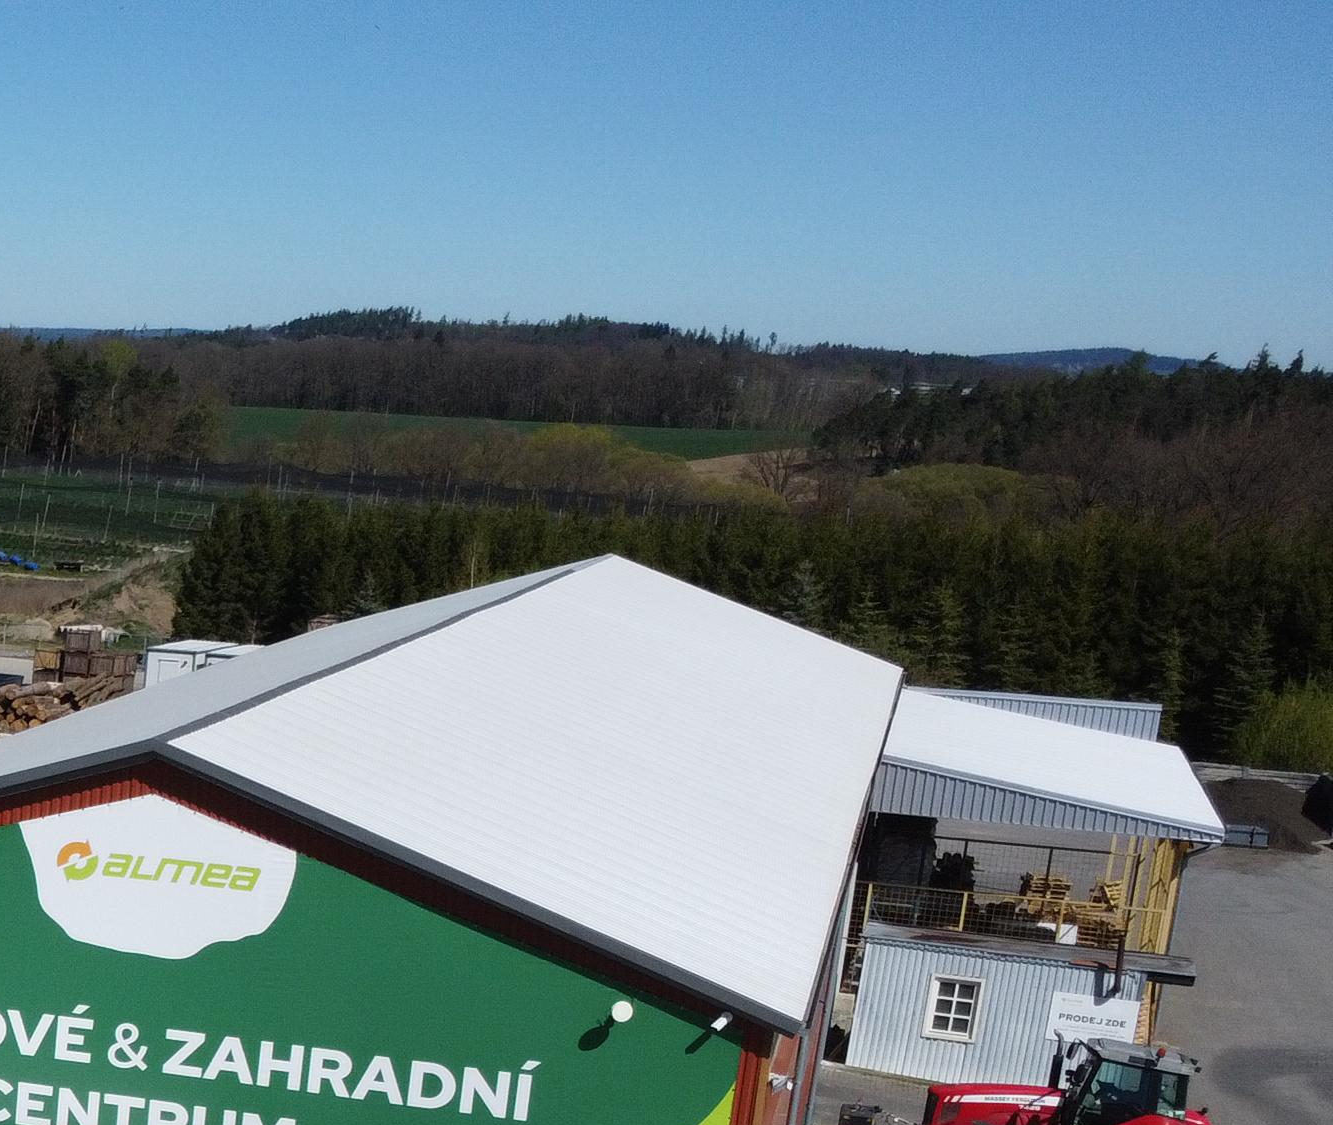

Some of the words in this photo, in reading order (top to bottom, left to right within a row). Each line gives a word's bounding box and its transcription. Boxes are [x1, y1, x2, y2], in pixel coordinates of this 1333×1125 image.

[1058, 1012, 1103, 1025] PRODEJ
[1105, 1018, 1127, 1029] ZDE
[108, 1022, 148, 1071] &
[163, 1028, 541, 1121] ZAHRADNÍ
